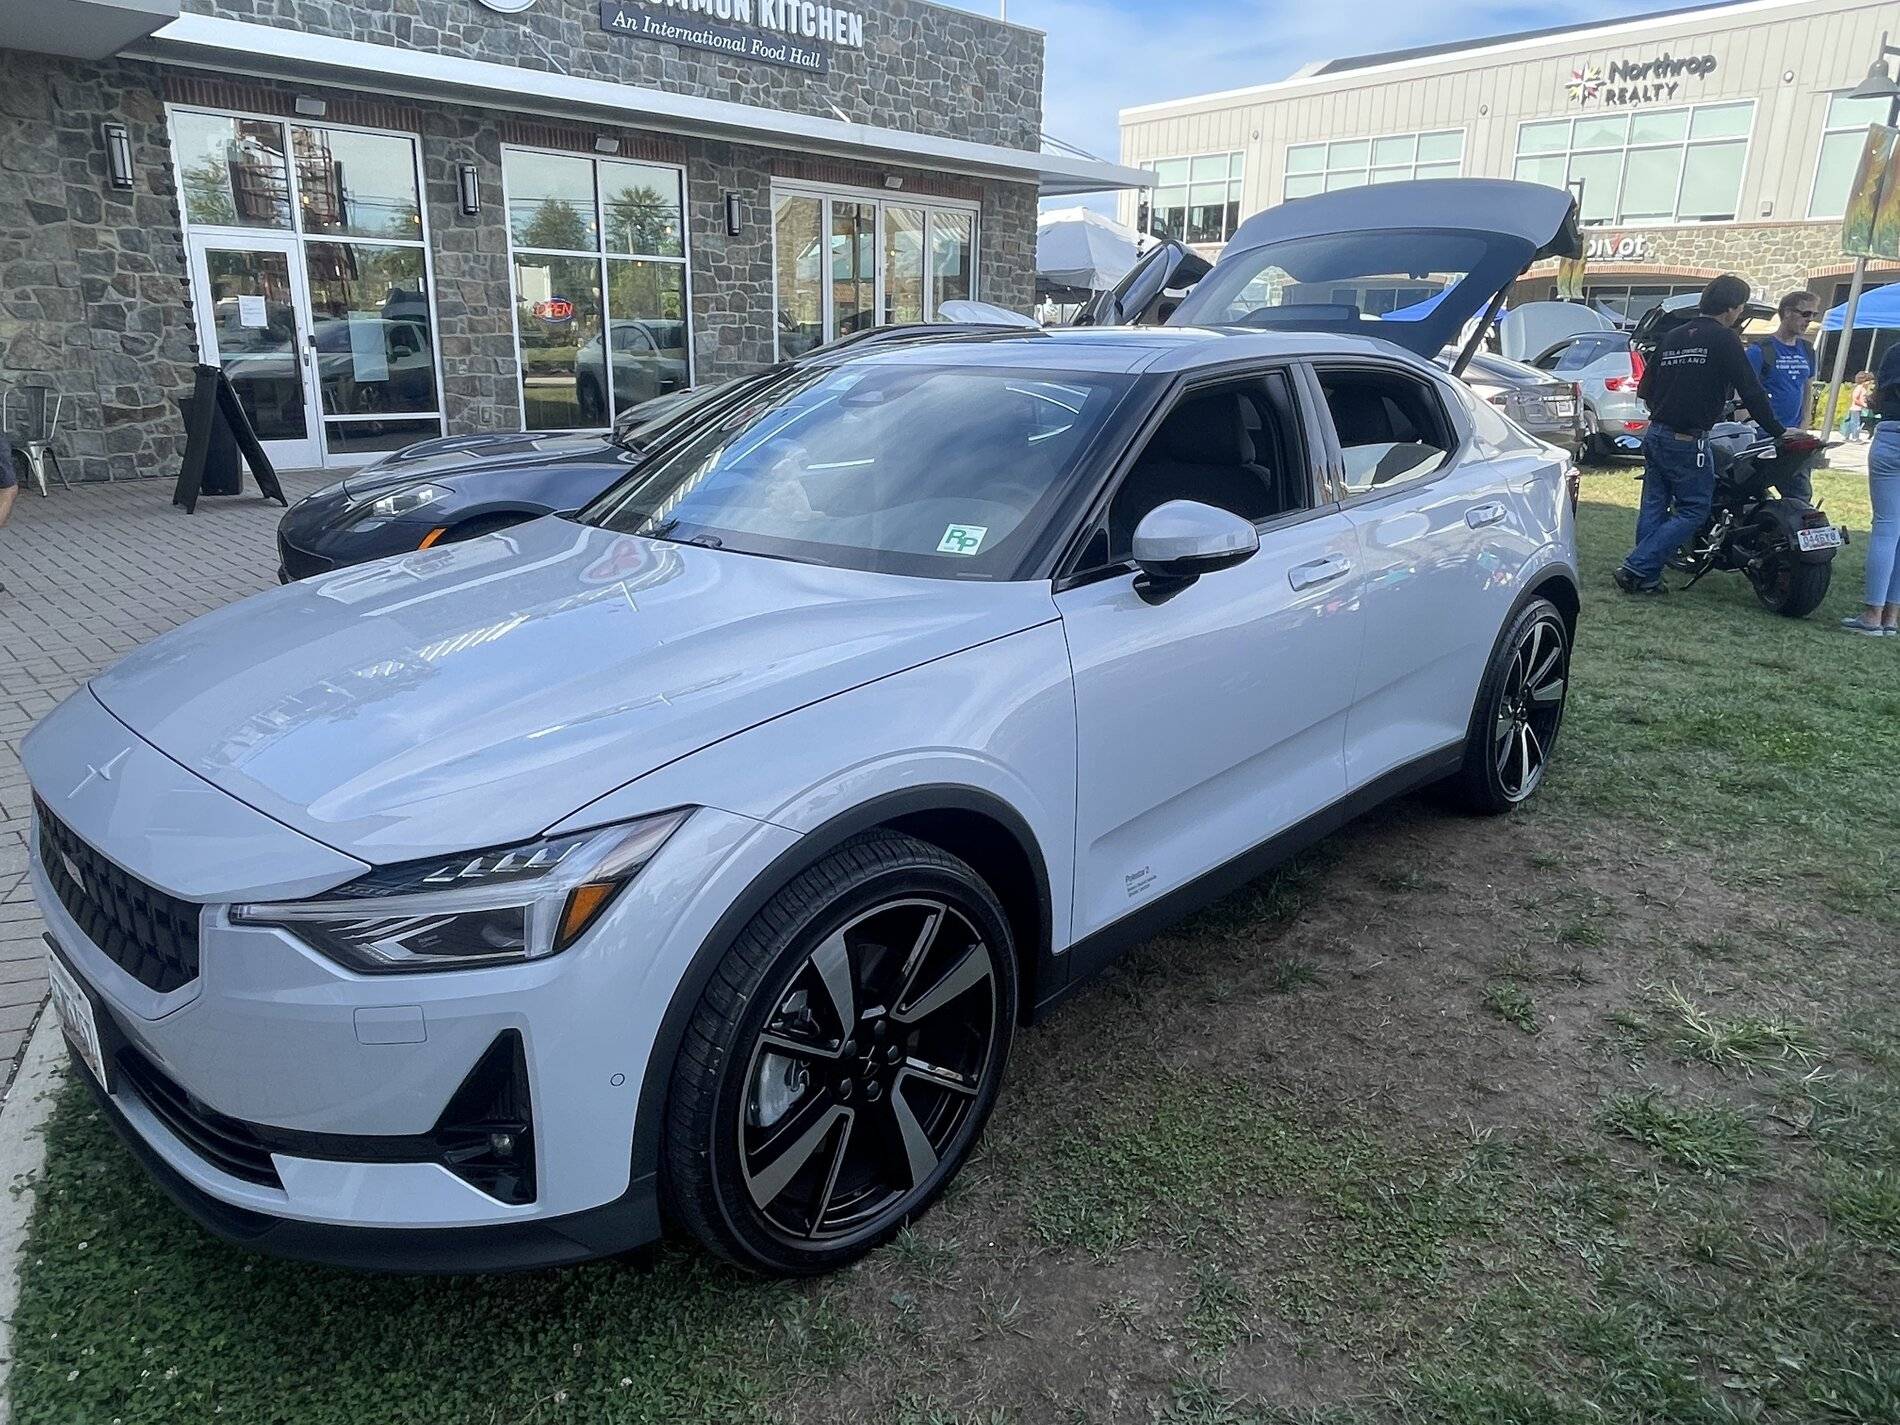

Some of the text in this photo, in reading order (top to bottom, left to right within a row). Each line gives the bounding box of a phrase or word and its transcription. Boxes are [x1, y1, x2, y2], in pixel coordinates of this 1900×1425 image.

[612, 10, 638, 31] An
[642, 15, 747, 52] International
[750, 38, 786, 61] Food
[788, 47, 821, 68] Hall
[760, 0, 863, 48] KITCHEN
[1608, 52, 1718, 84] Northrop
[1605, 82, 1679, 106] REALTY
[533, 301, 573, 317] OPEN
